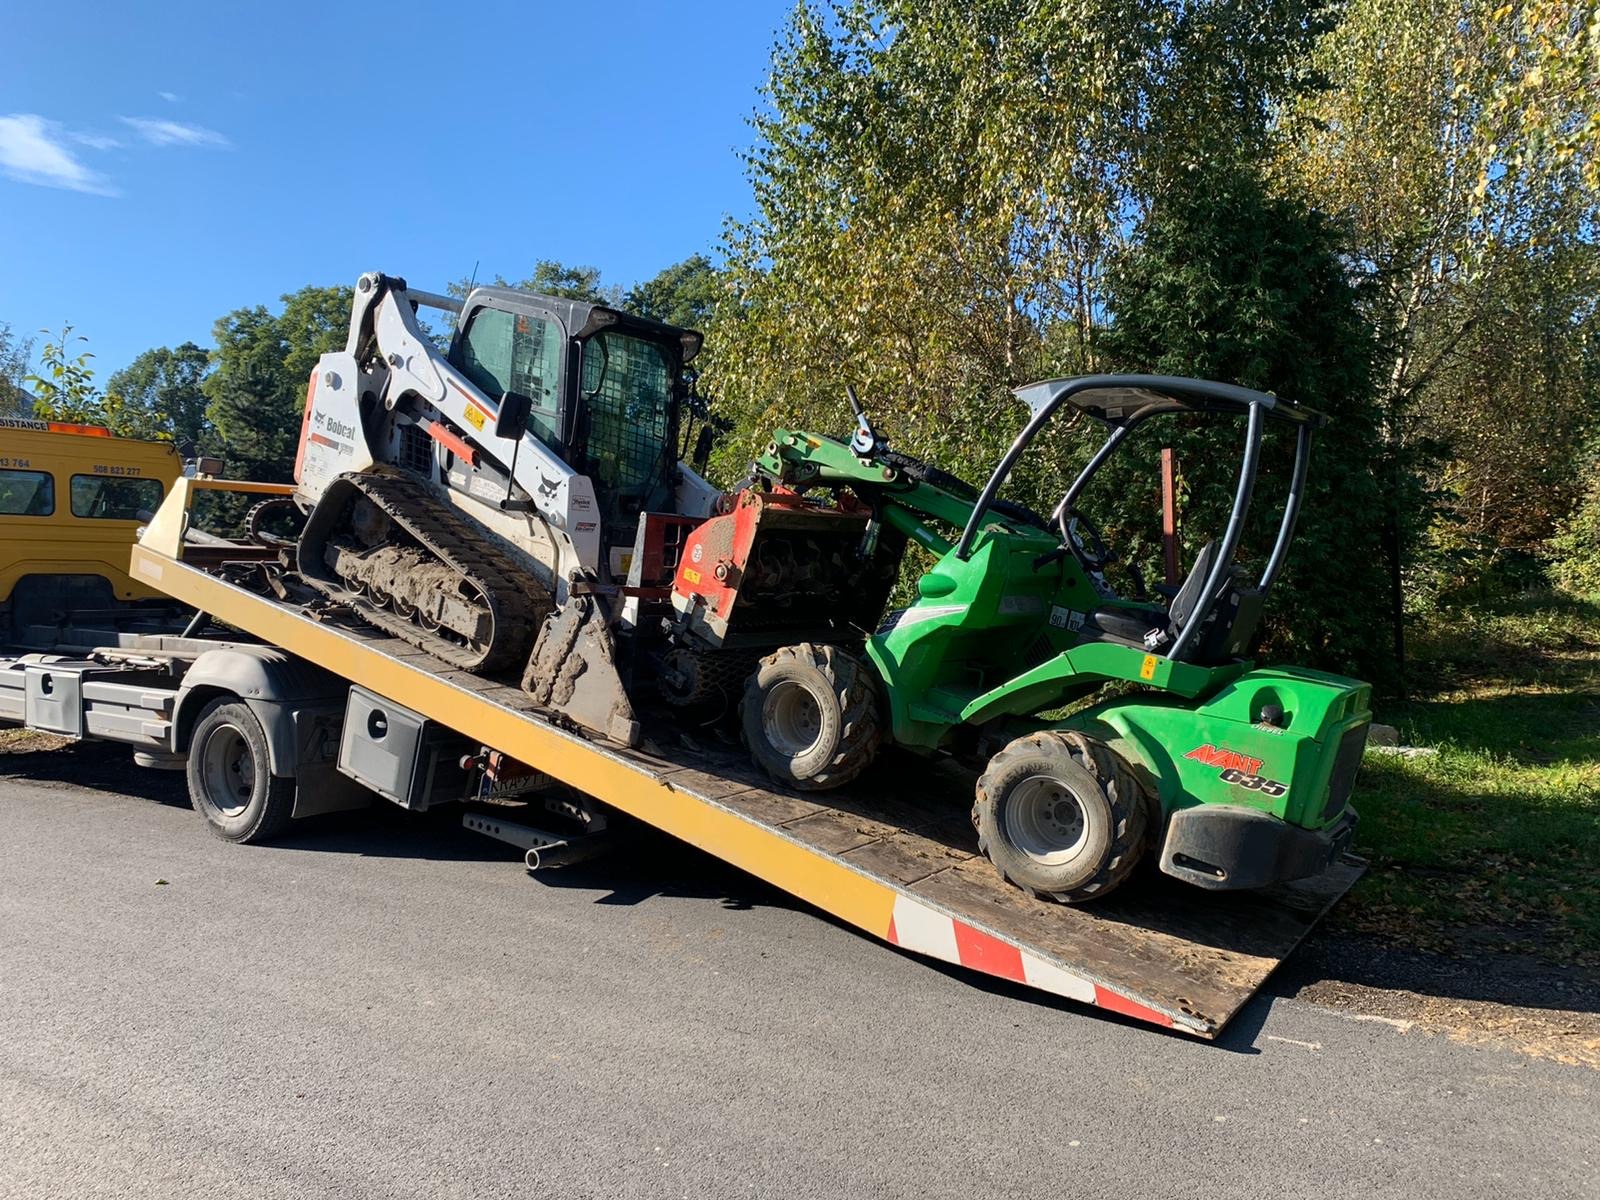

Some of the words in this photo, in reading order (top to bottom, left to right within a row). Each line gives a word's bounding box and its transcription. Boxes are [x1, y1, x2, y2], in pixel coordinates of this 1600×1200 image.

[326, 417, 356, 440] Bobcat
[1182, 743, 1264, 776] AVANT
[1219, 768, 1289, 797] 635
